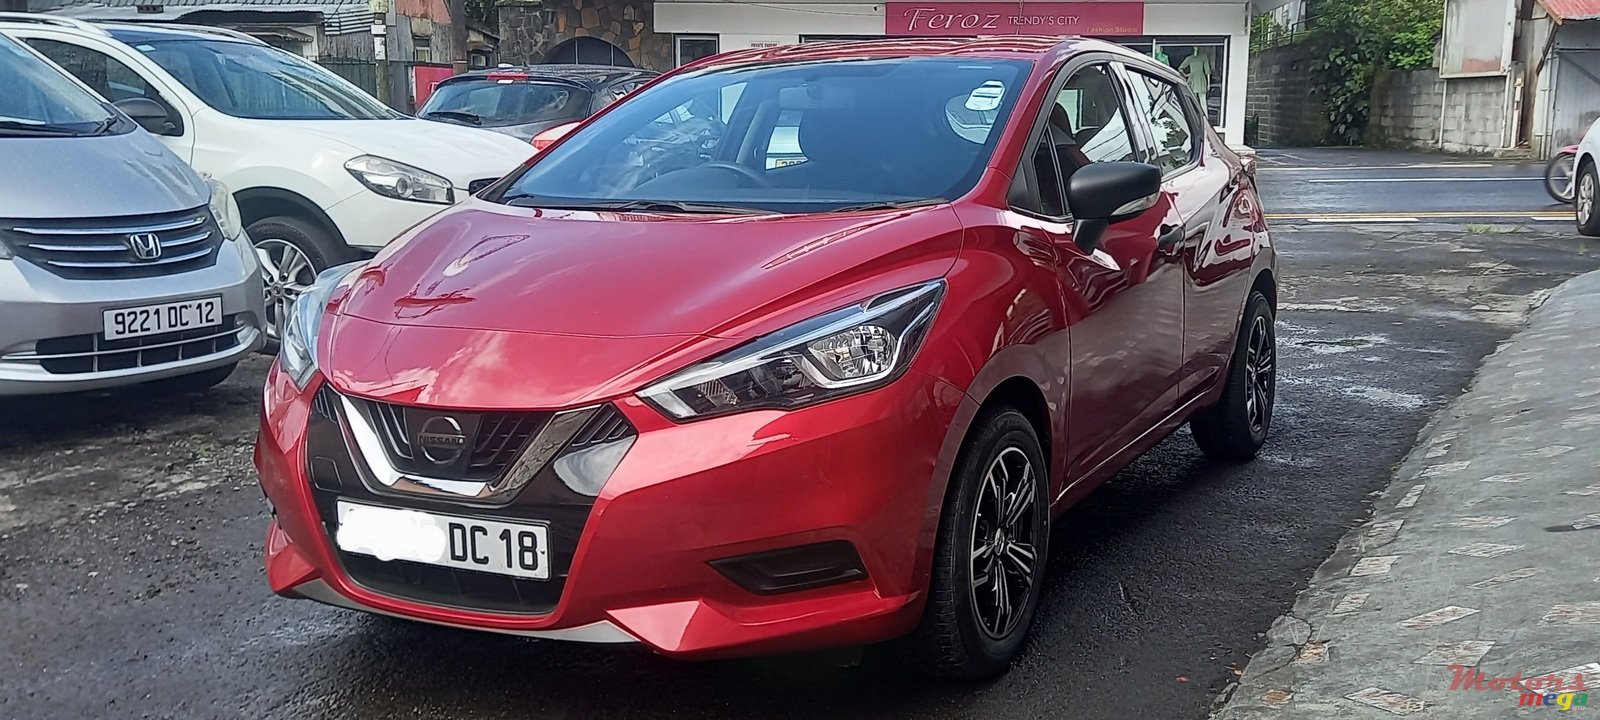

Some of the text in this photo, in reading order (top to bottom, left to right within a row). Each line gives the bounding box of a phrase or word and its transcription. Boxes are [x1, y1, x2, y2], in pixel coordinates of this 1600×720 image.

[904, 8, 1000, 31] Feroz
[1008, 16, 1079, 25] TRENDY'S CITY
[115, 301, 215, 335] 9221 DC 12
[419, 435, 464, 446] NISSAN
[449, 522, 538, 571] DC 18
